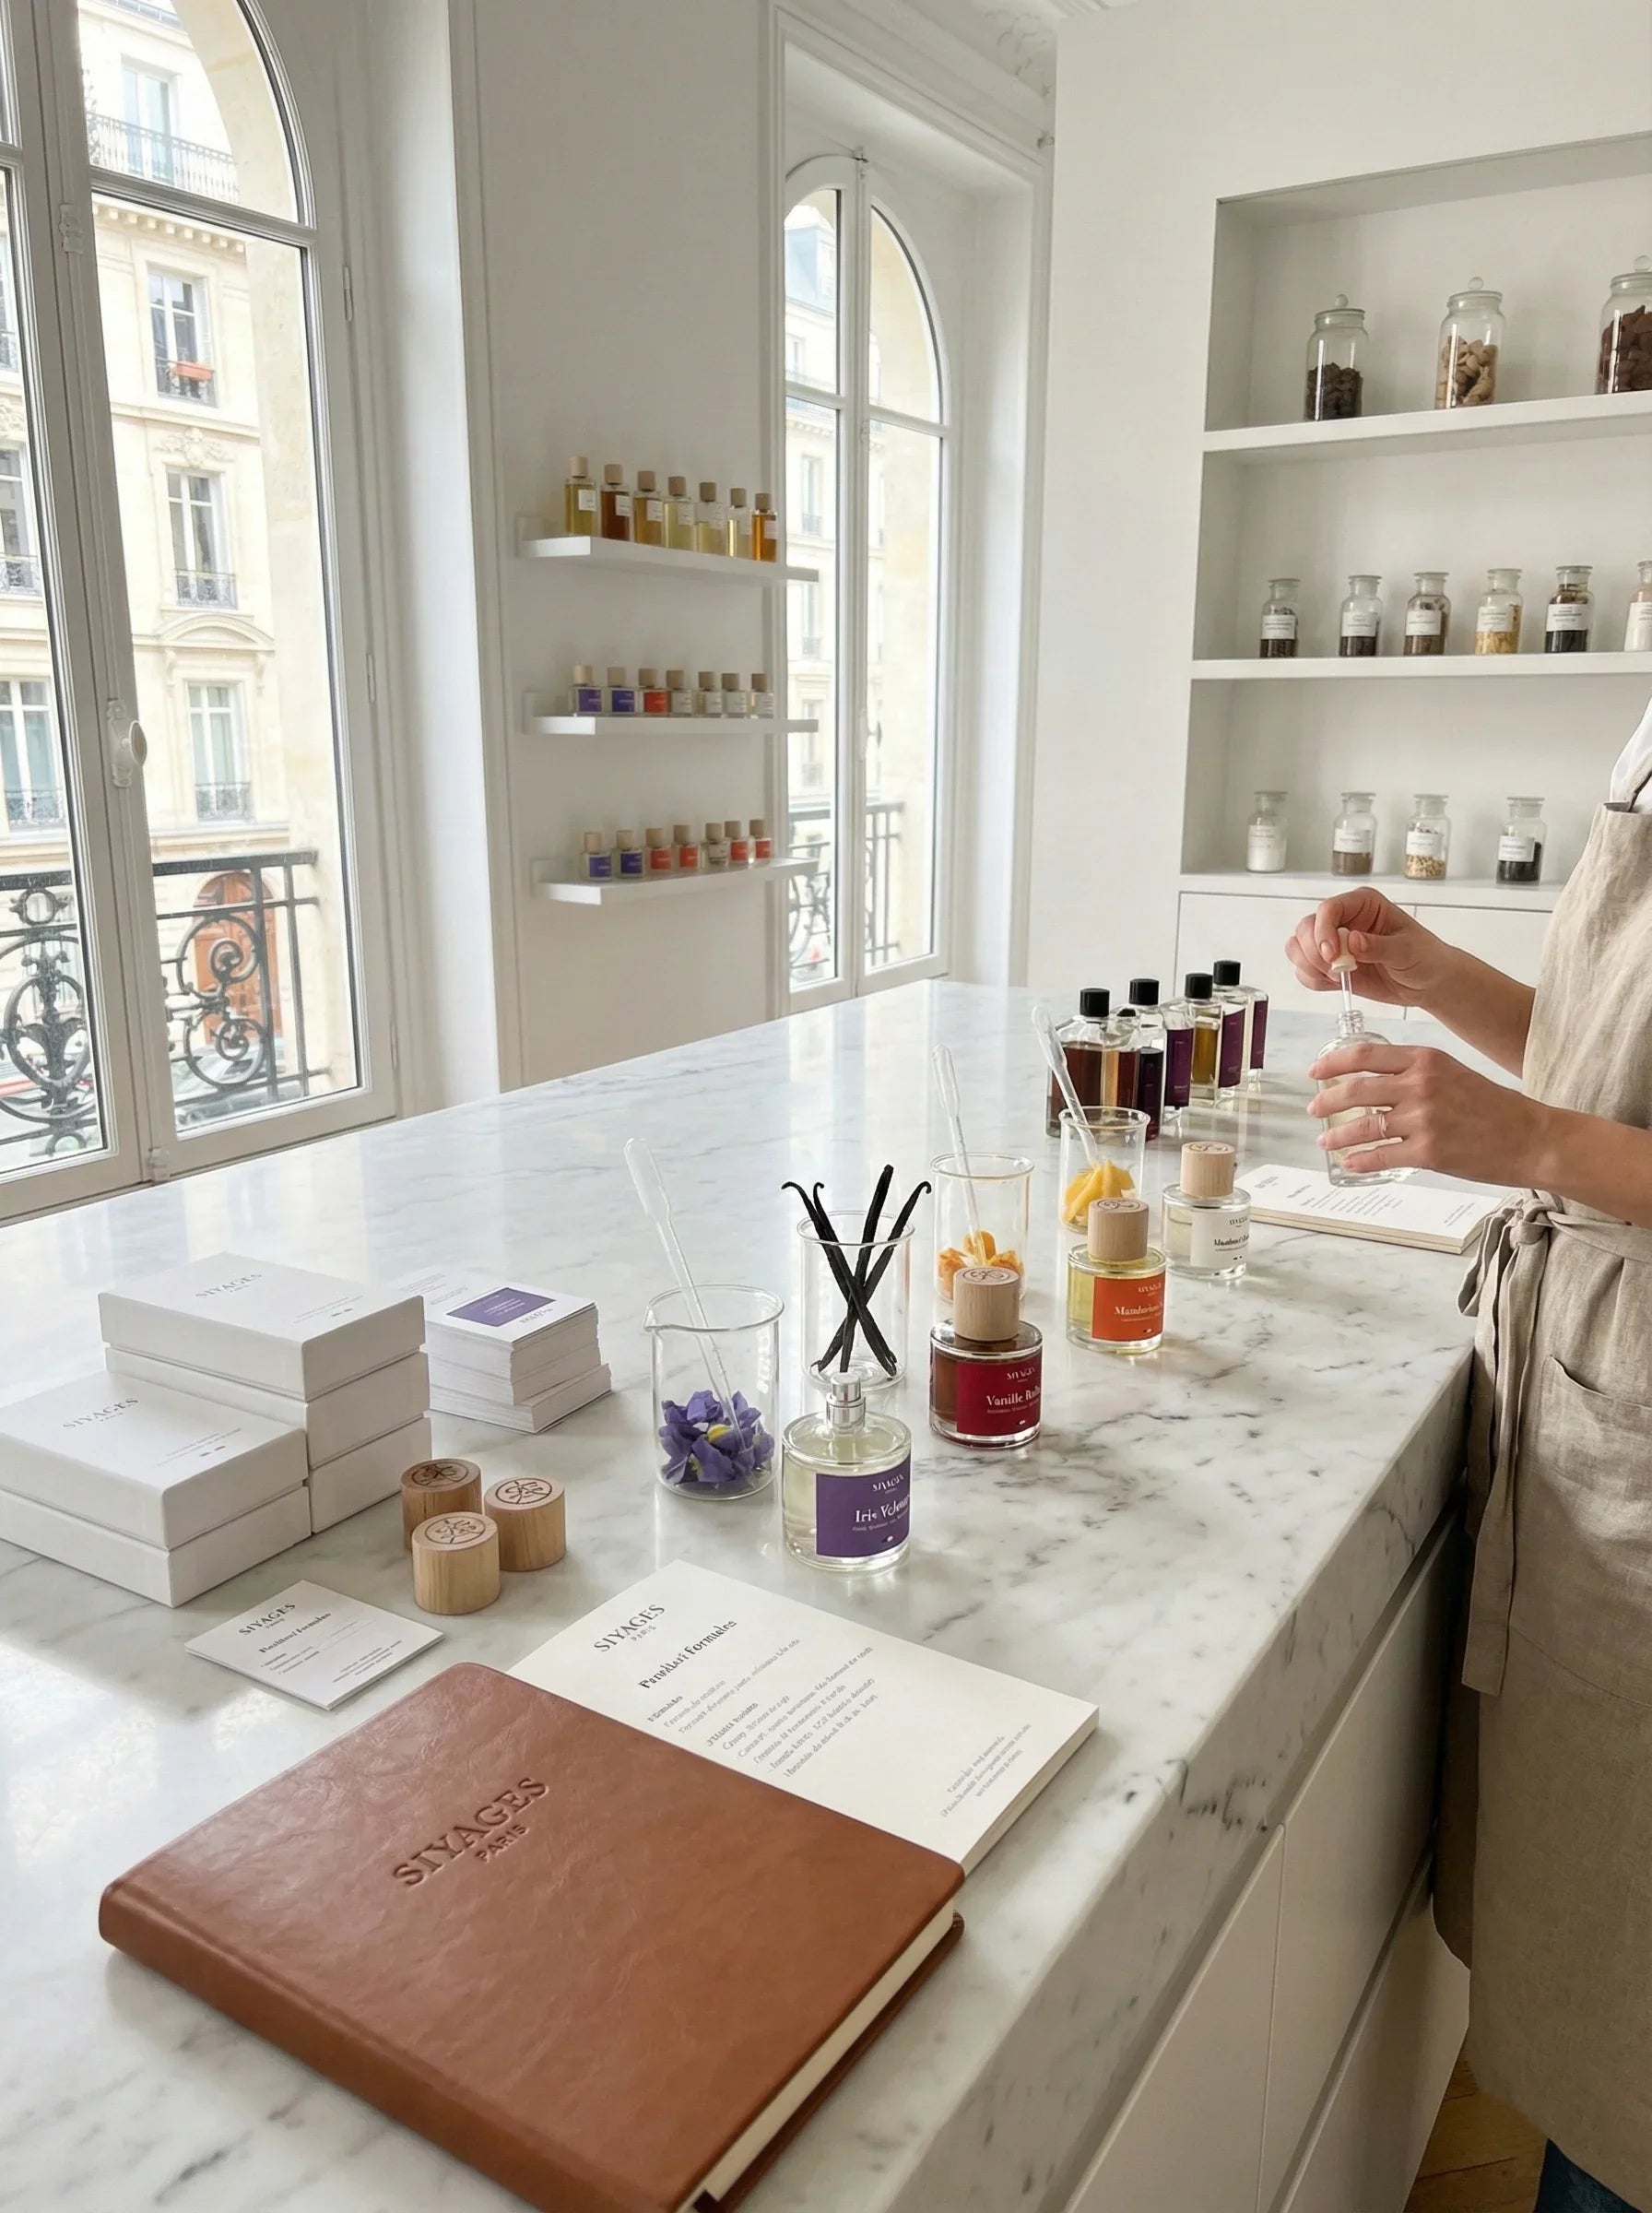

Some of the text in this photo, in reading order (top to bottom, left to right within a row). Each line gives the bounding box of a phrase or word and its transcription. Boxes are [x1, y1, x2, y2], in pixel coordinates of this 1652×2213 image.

[985, 1392, 1024, 1406] Vanille
[855, 1509, 879, 1523] Iris
[593, 1604, 666, 1652] SIYAGES
[392, 1777, 549, 1889] SIYAGES
[474, 1823, 529, 1864] PARIS
